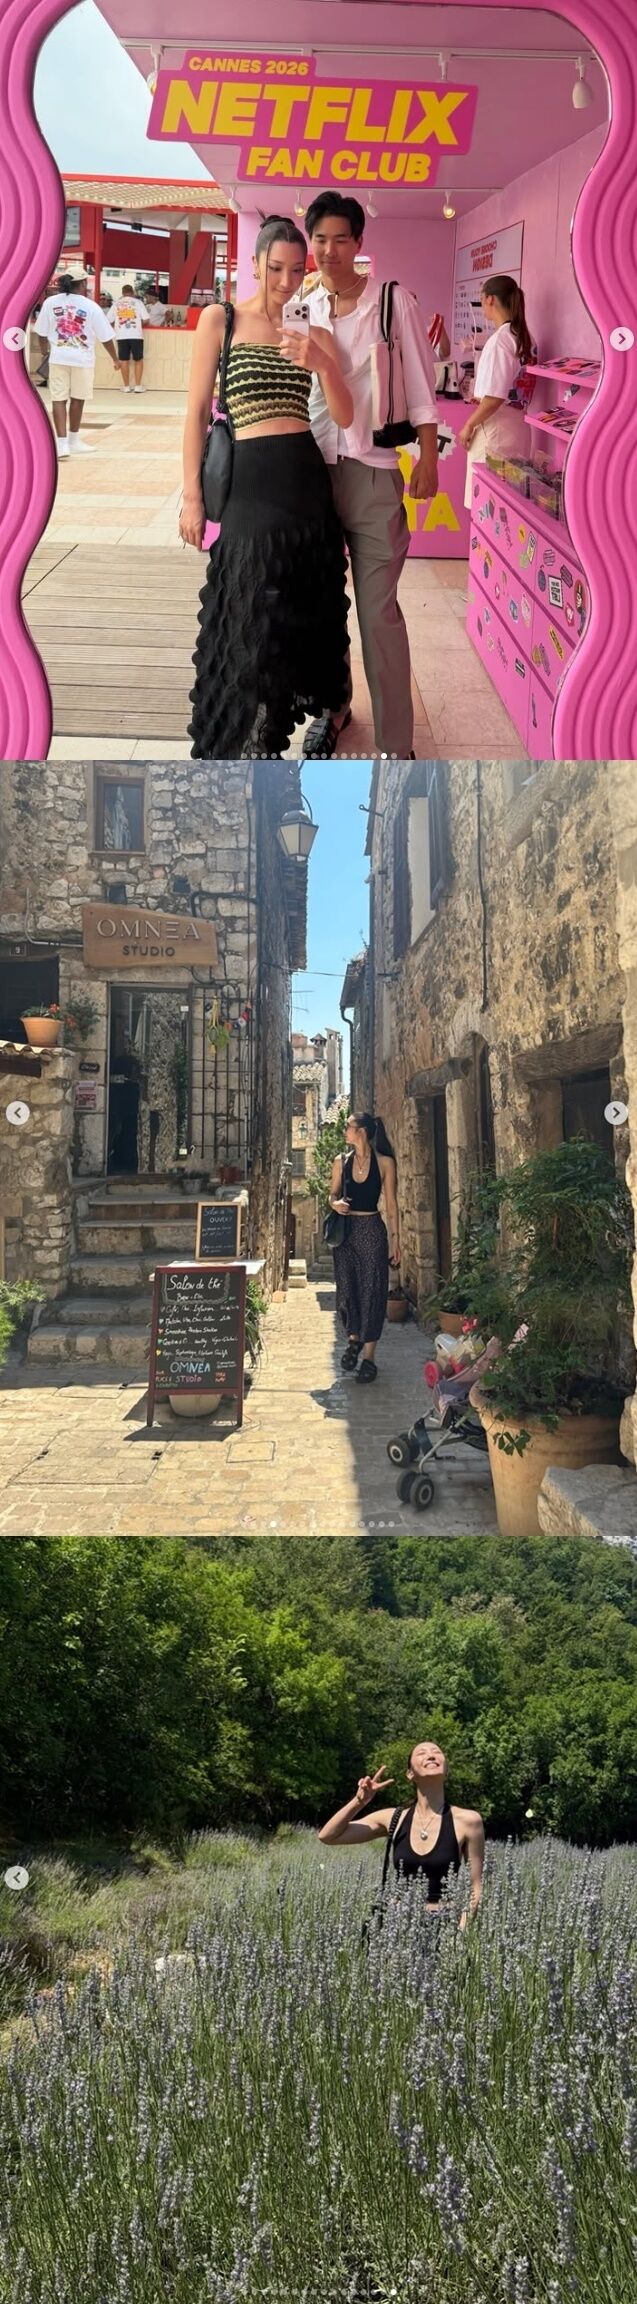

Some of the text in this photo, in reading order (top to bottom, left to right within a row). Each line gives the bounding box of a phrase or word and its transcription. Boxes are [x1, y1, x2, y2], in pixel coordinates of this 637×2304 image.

[188, 56, 309, 77] CANNES 2026
[160, 79, 470, 146] NETFLIX
[245, 146, 431, 184] FAN CLUB
[122, 945, 176, 957] STUDIO
[166, 1274, 224, 1291] Salon de thé
[169, 1361, 211, 1374] OMNEA
